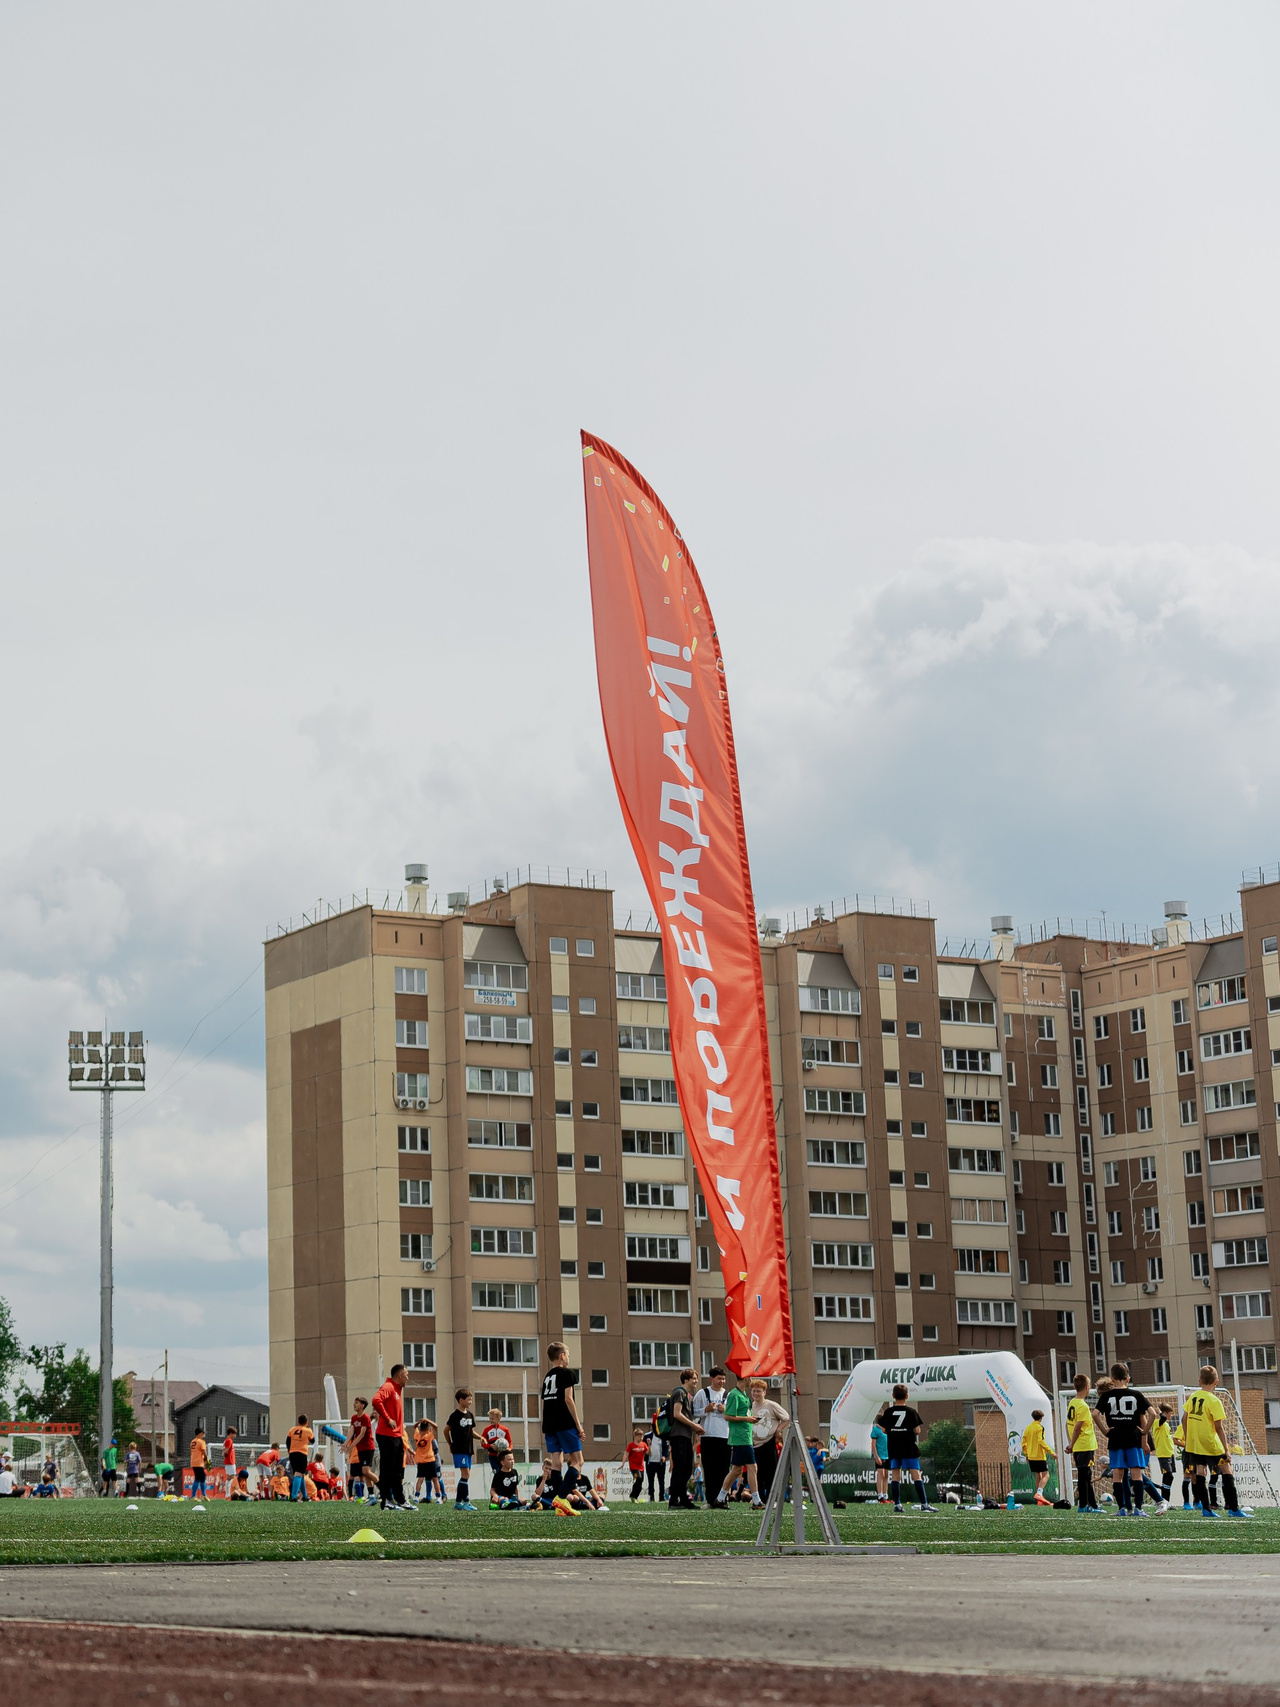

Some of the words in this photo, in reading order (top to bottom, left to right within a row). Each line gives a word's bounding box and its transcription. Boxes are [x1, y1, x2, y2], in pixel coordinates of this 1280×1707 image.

[646, 635, 735, 1147] ПОБЕЖДАЙ!
[544, 1374, 559, 1395] 11
[1107, 1395, 1138, 1415] 10
[1189, 1397, 1206, 1416] 11
[892, 1410, 907, 1427] 7
[293, 1428, 303, 1438] 4
[820, 1473, 856, 1485] ВИЗИОН
[1235, 1476, 1261, 1486] НАТОРА
[1238, 1487, 1265, 1499] ИНСКОЙ
